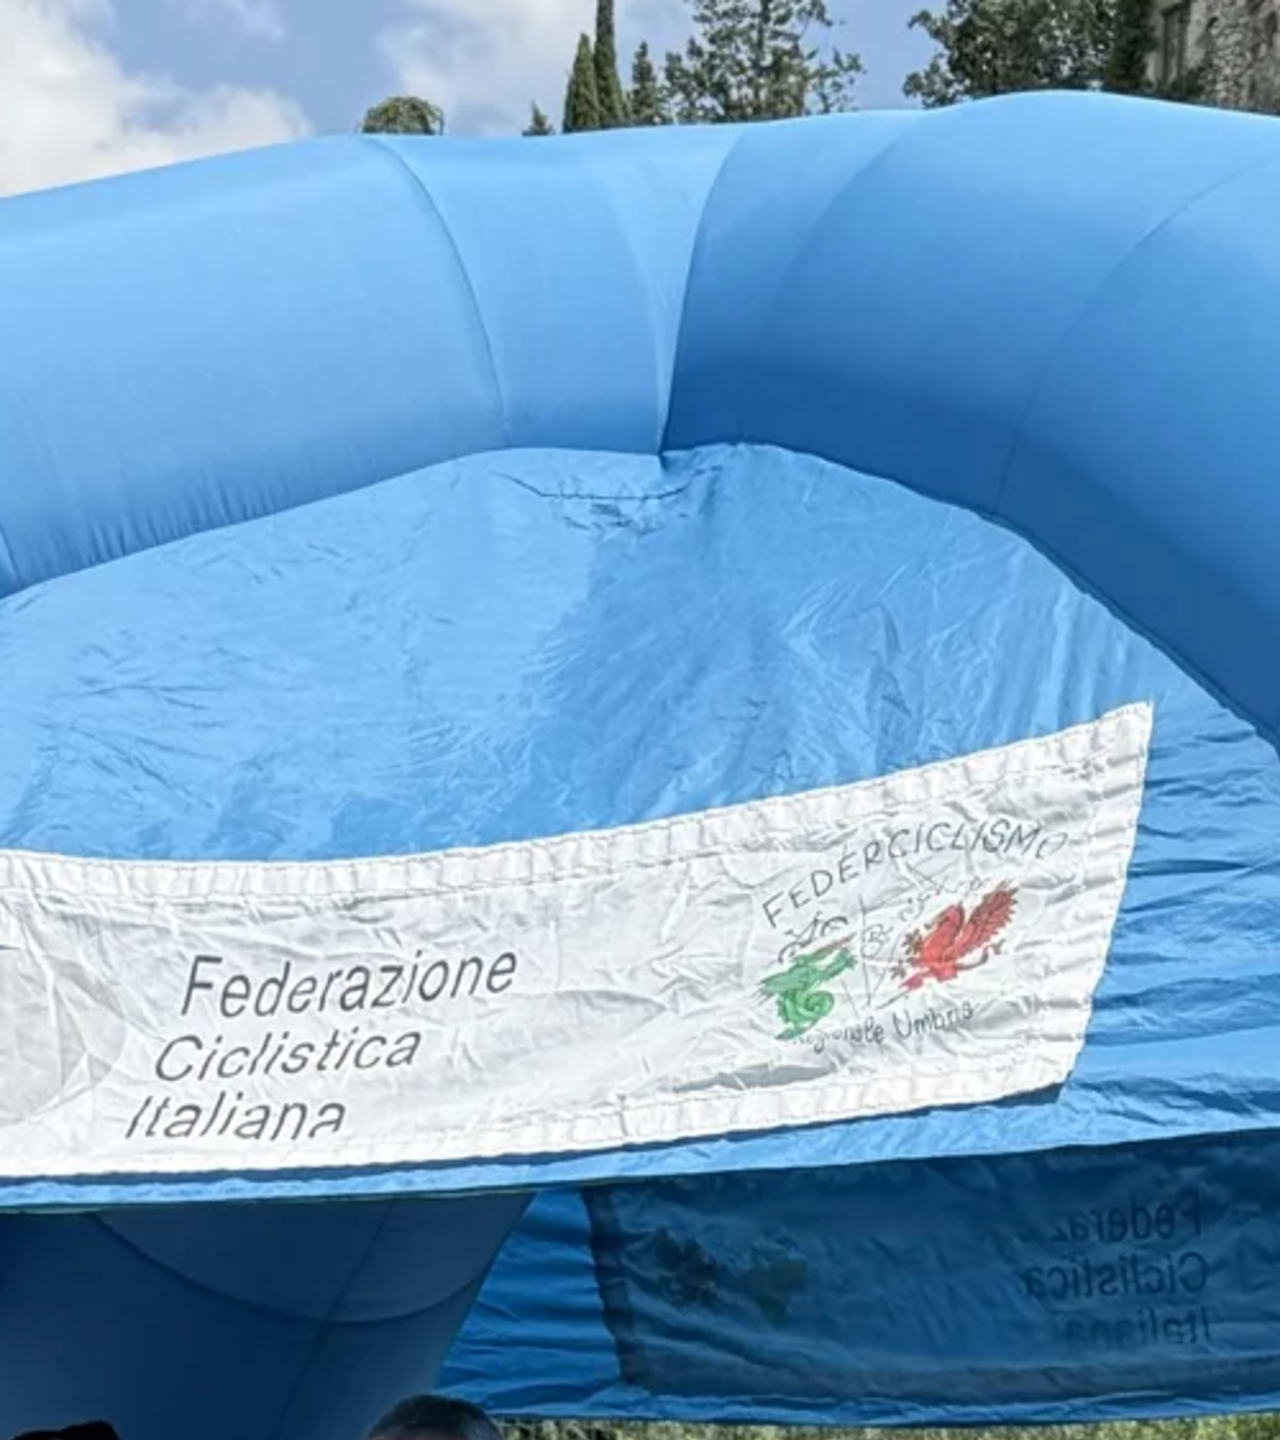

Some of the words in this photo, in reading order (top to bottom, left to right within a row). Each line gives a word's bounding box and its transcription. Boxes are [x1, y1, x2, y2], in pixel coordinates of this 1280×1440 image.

[762, 818, 1068, 928] FEDERCICLISMO
[181, 949, 519, 1019] Federazione
[892, 1002, 974, 1039] Umbria
[155, 1026, 422, 1082] Ciclistica
[125, 1090, 347, 1142] Italiana
